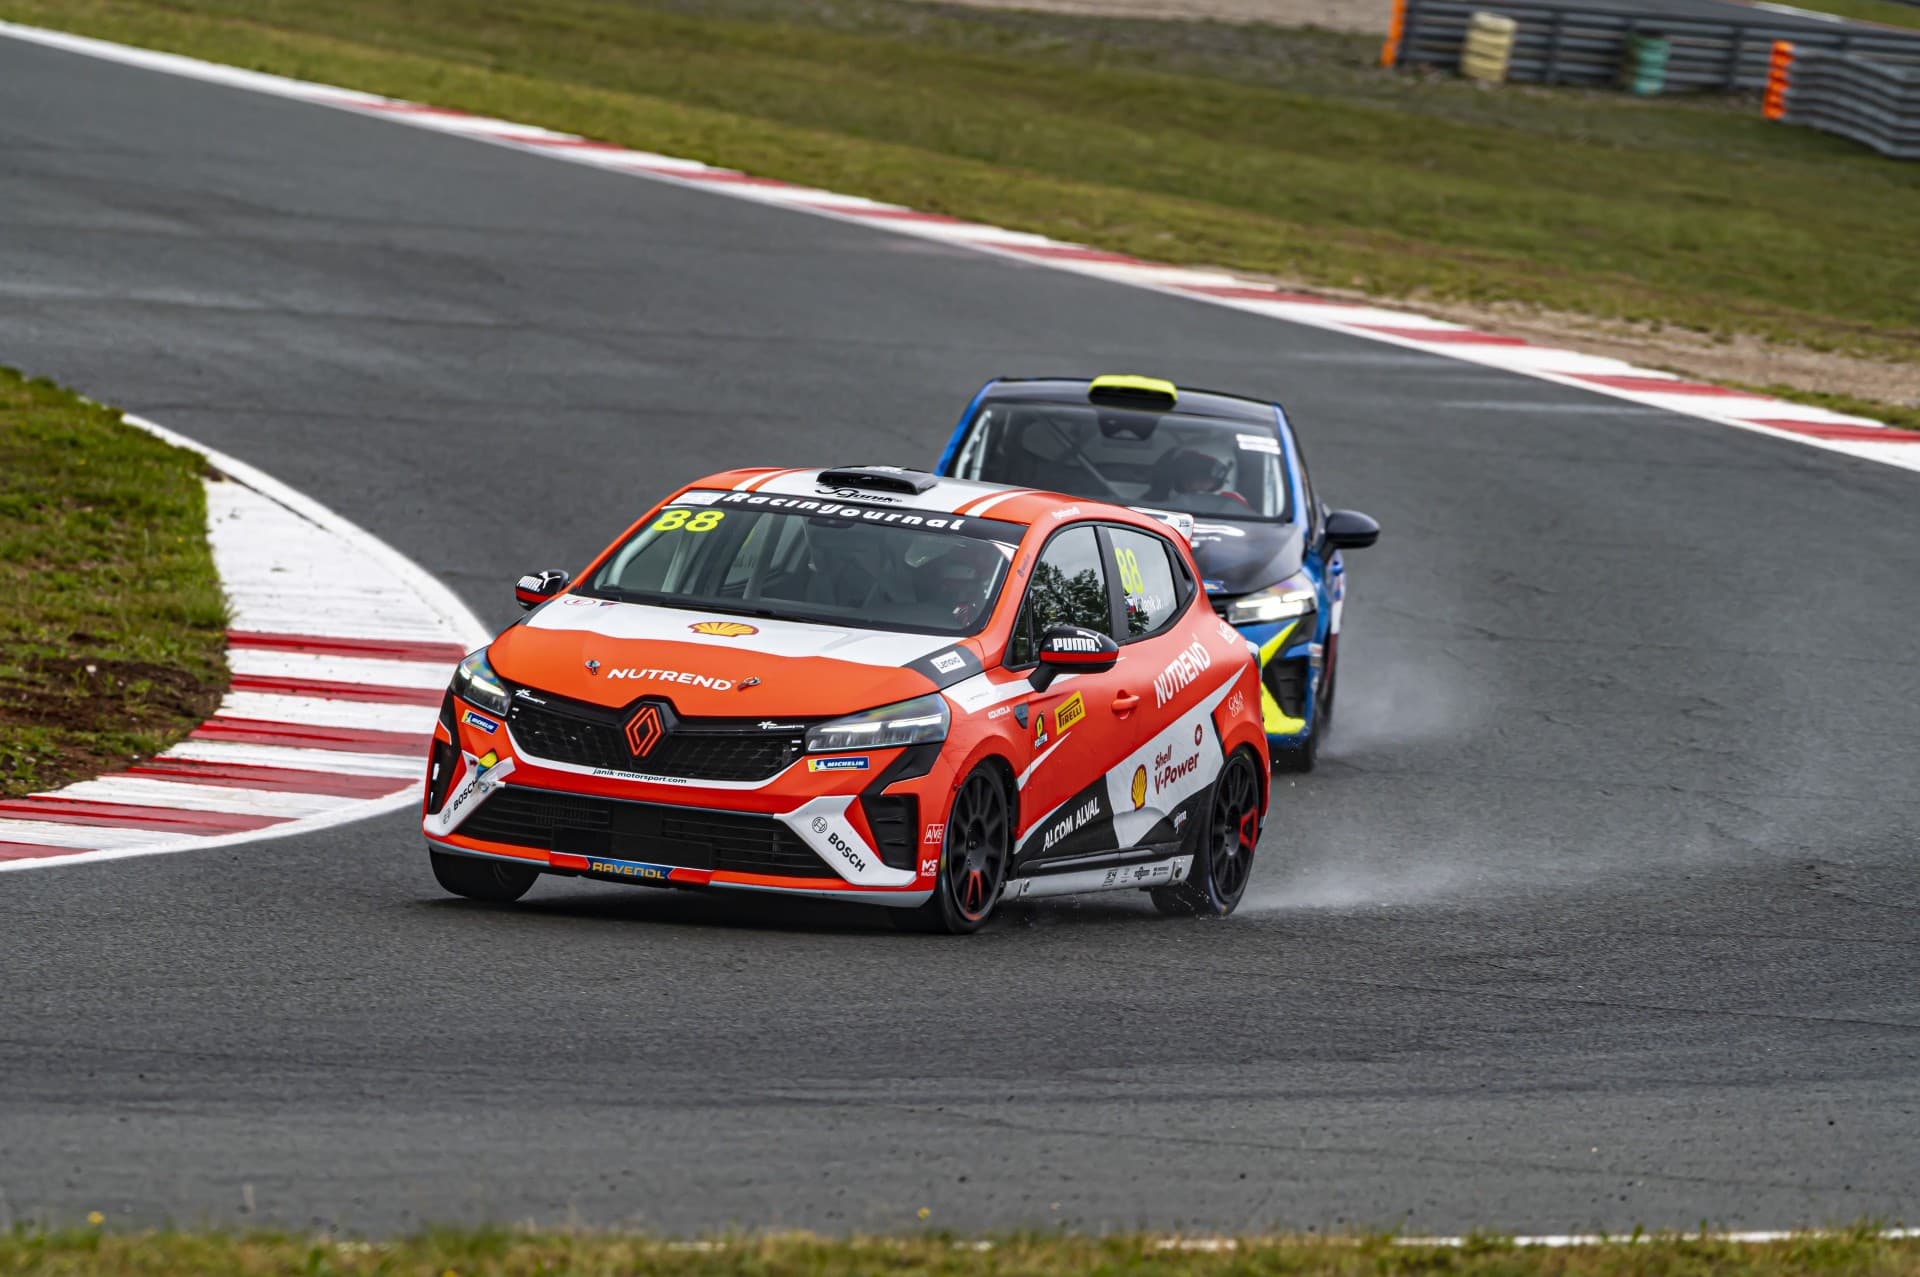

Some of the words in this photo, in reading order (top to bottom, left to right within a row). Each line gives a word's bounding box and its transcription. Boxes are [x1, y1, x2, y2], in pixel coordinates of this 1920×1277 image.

[652, 510, 725, 532] 88
[1115, 547, 1144, 595] 88
[607, 668, 732, 691] NUTREND
[1153, 640, 1211, 709] NUTREND
[1058, 698, 1082, 728] PIRELLI
[827, 760, 865, 768] MICHELIN
[1154, 744, 1172, 771] Shell
[1154, 752, 1200, 795] V-Power
[453, 778, 478, 811] BOSCH
[1042, 814, 1074, 852] ALCOM
[1075, 797, 1100, 829] ALVAL
[827, 832, 867, 873] BOSCH
[592, 861, 665, 880] RAVENOL
